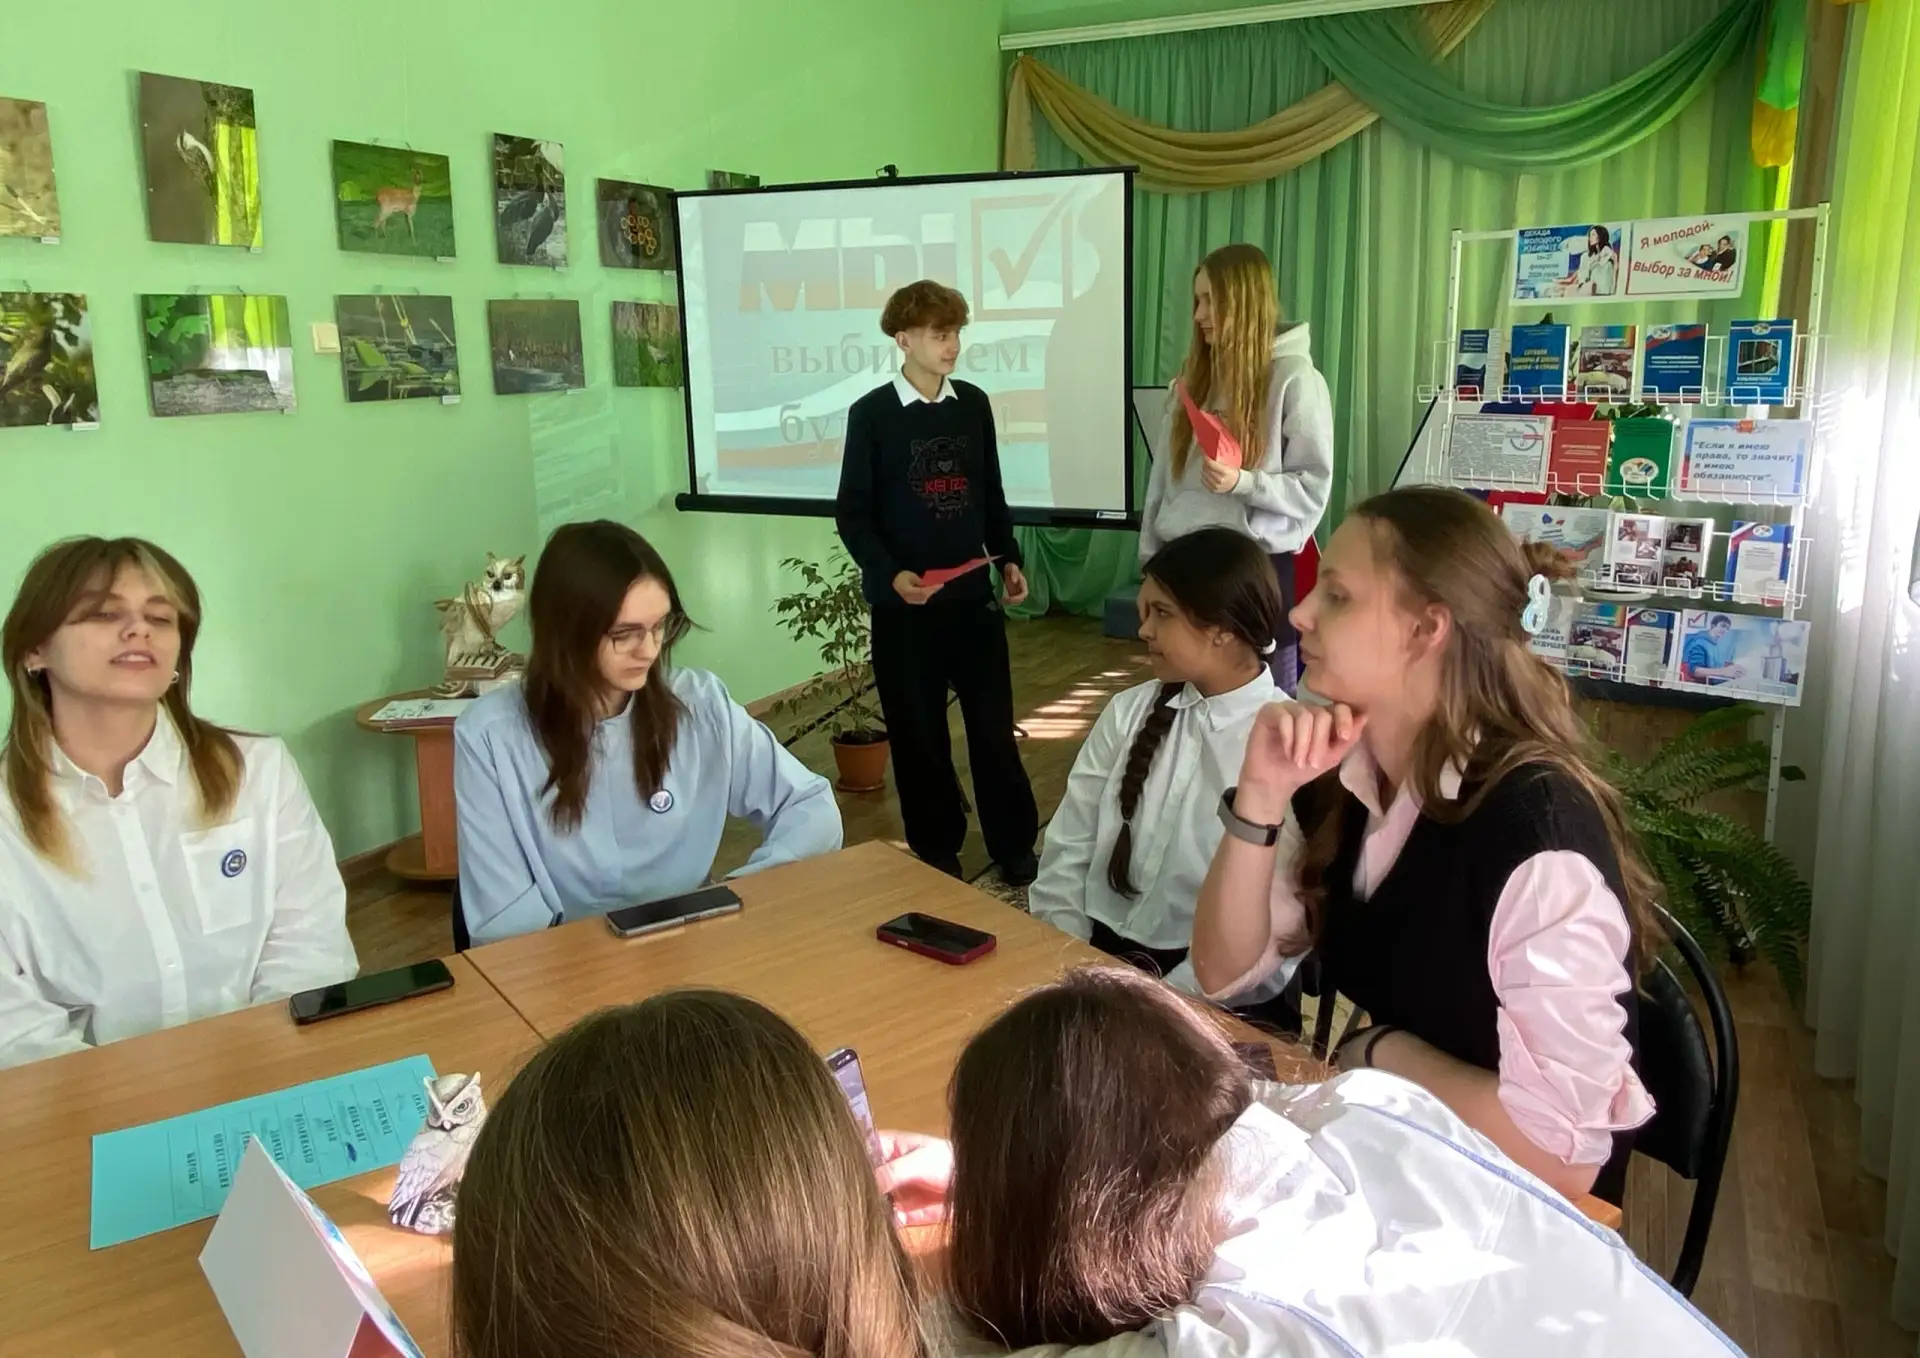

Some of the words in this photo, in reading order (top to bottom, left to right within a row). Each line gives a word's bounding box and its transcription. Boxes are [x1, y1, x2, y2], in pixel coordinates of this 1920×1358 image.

[1640, 237, 1650, 249] Я
[1652, 222, 1715, 246] молодой-
[738, 213, 958, 312] МЫ
[1633, 261, 1675, 279] выбор
[1677, 268, 1692, 278] за
[770, 332, 1030, 376] выбием
[1750, 454, 1795, 463] значит,
